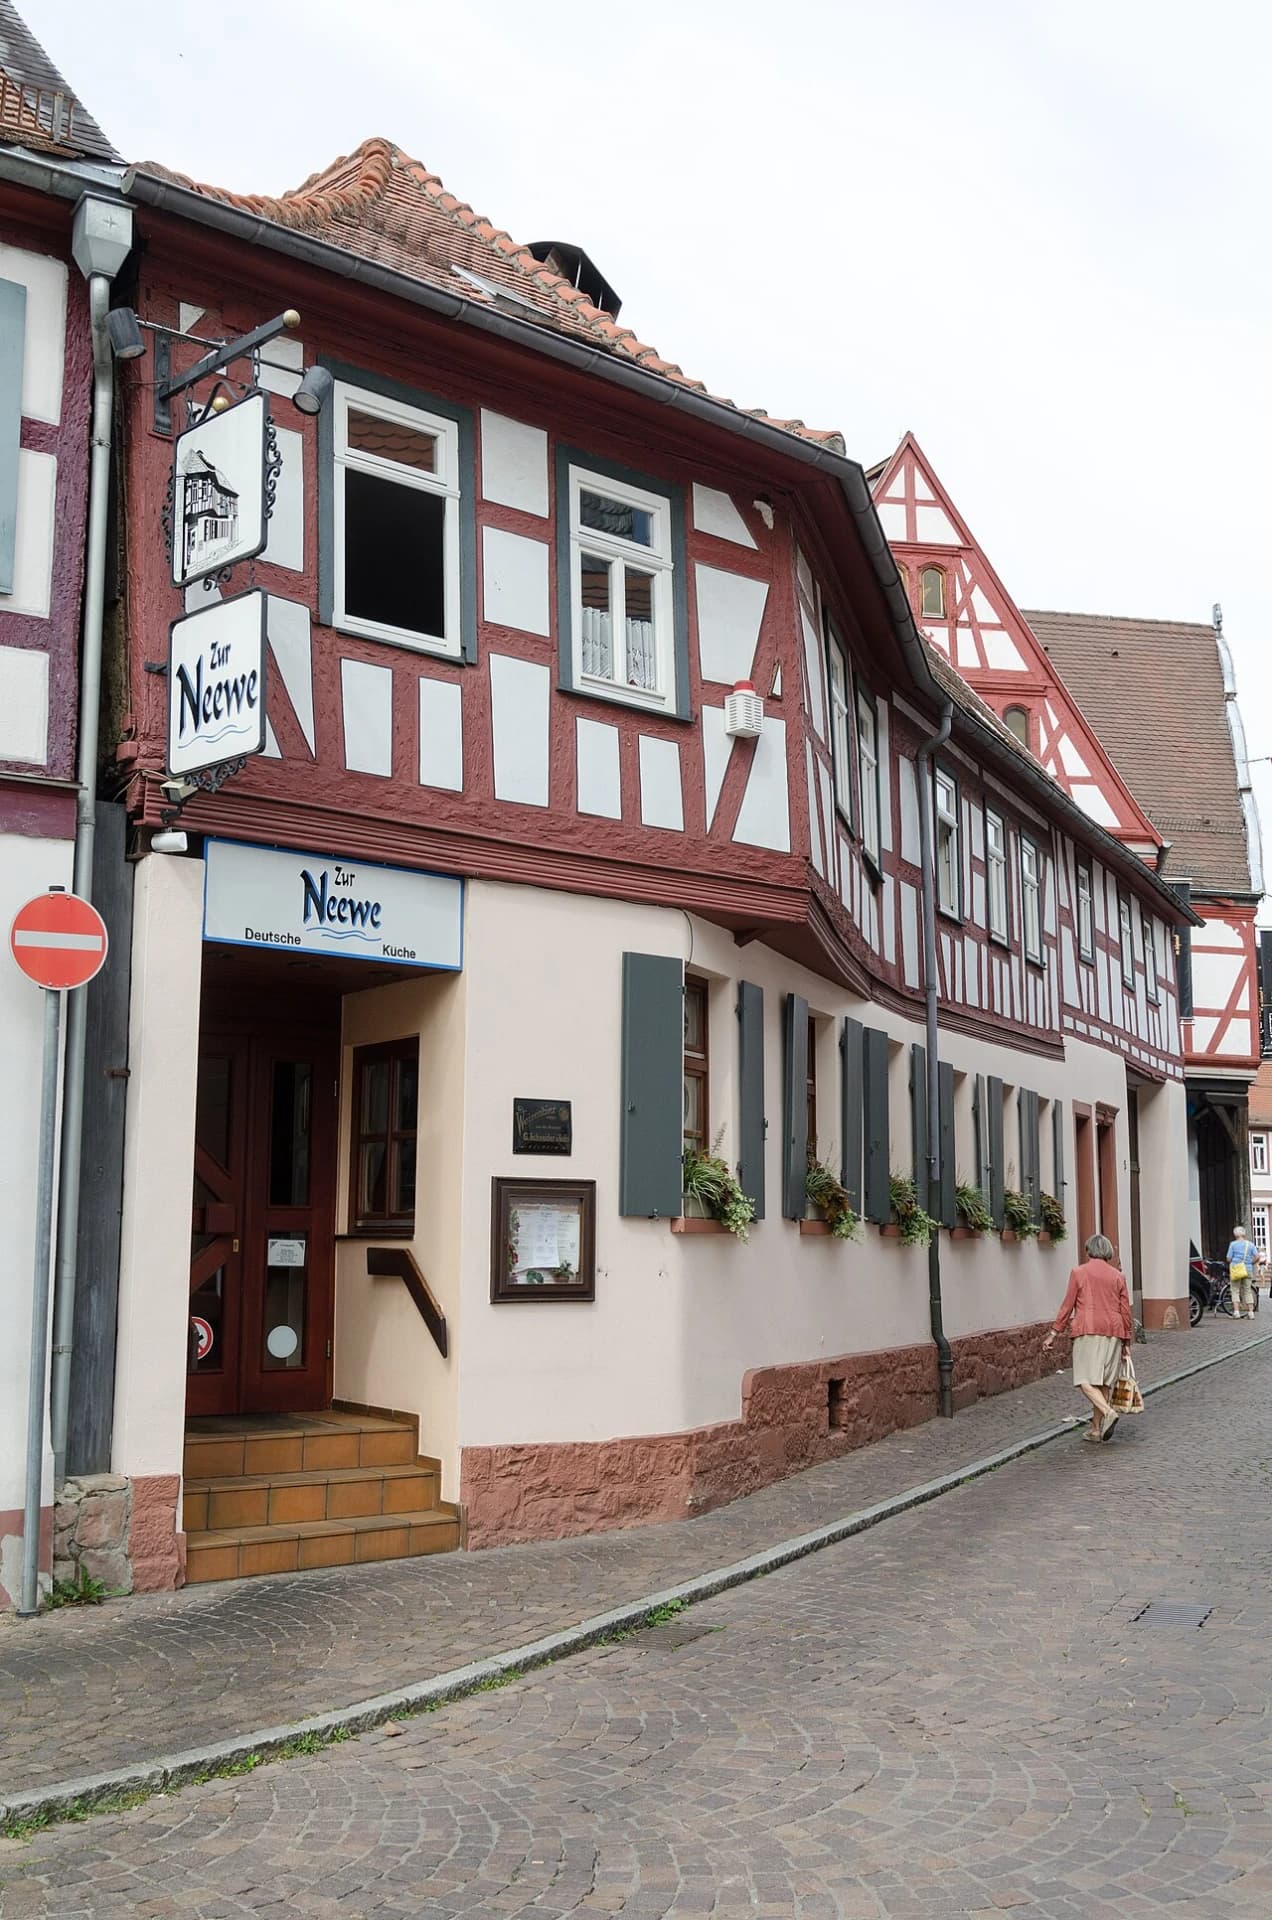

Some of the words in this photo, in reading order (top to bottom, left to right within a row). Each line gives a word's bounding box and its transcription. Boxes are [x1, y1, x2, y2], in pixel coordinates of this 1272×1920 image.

[210, 642, 231, 669] Zur
[176, 655, 258, 738] Neewe
[334, 866, 356, 888] Zur
[300, 869, 382, 929] Neewe
[245, 928, 302, 944] Deutsche
